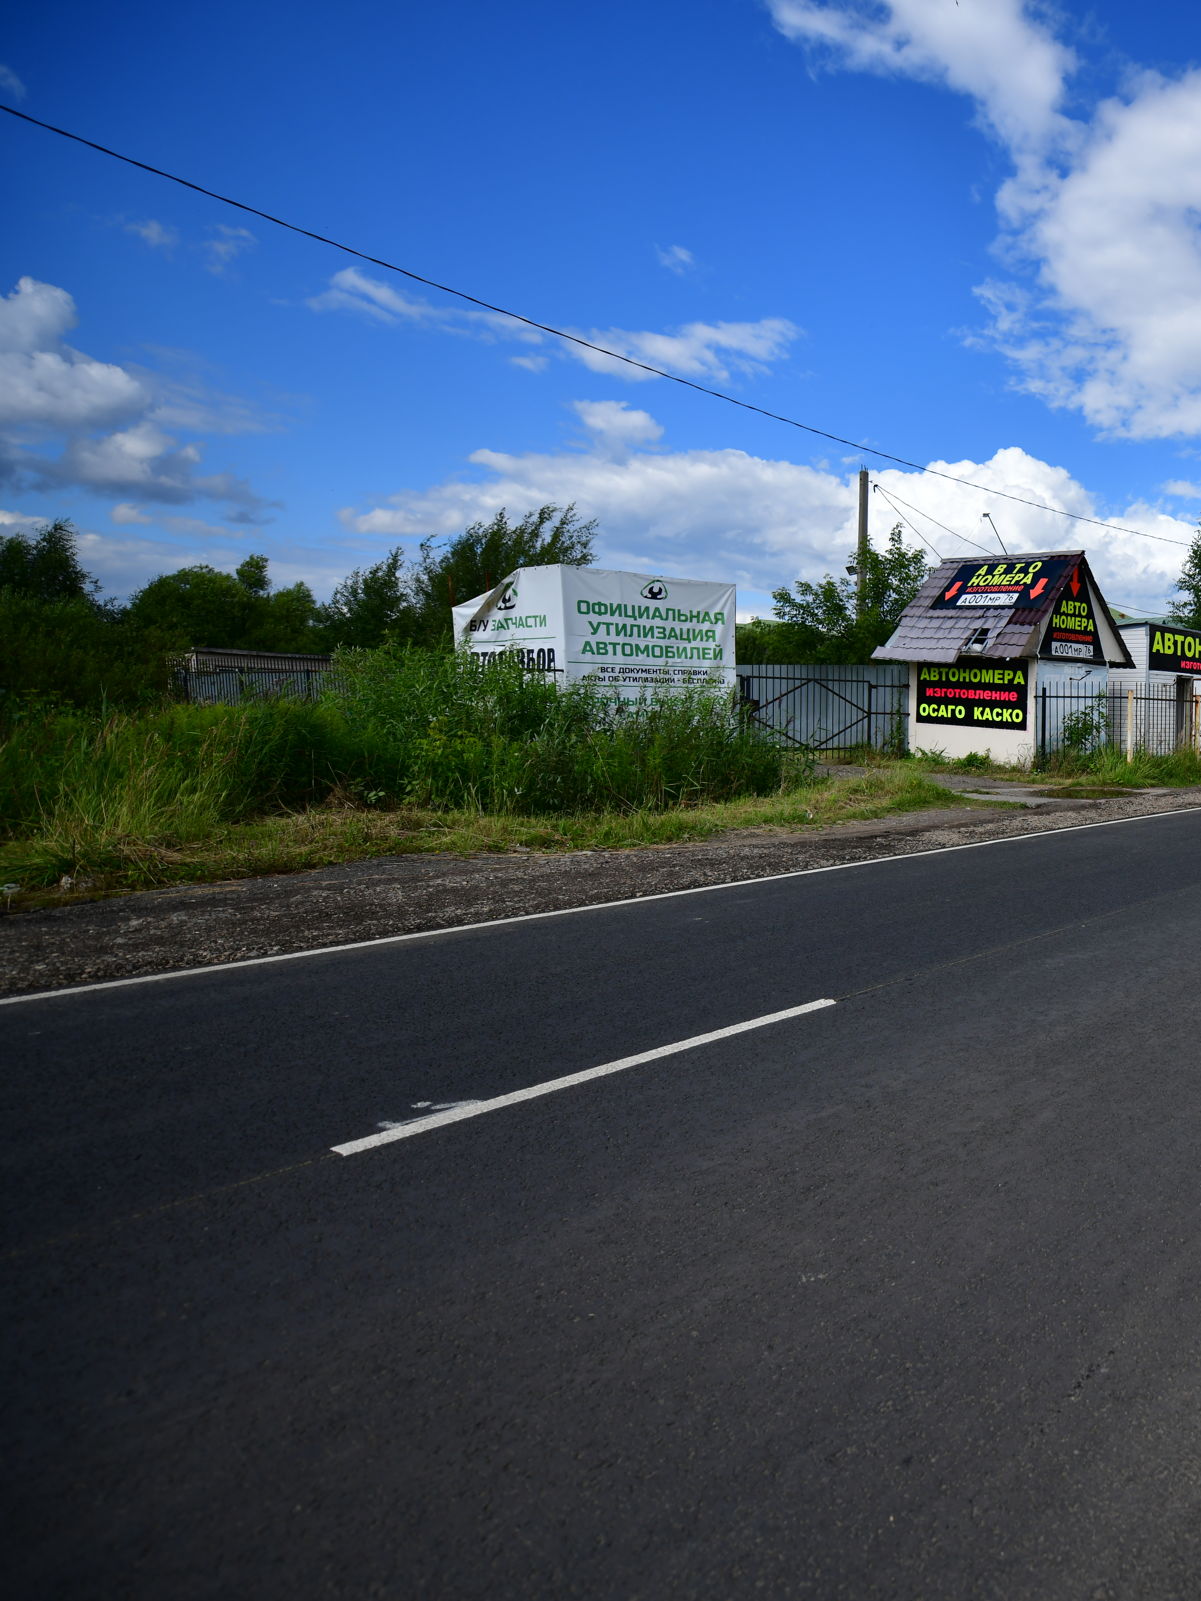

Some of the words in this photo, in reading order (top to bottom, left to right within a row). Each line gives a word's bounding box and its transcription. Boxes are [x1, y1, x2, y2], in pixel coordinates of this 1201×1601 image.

[974, 561, 1043, 576] АВТО
[967, 573, 1034, 586] НОМЕРА
[576, 600, 726, 625] ОФИЦИАЛЬНАЯ
[1060, 600, 1088, 616] АВТО
[469, 619, 489, 632] Б/У
[588, 620, 717, 643] УТИЛИЗАЦИЯ
[1052, 614, 1095, 632] НОМЕРА
[580, 641, 723, 661] АВТОМОБИЛЕЙ
[600, 666, 616, 674] ВСЕ
[920, 667, 1025, 685] АВТОНОМЕРА
[926, 688, 1018, 702] изготовление
[919, 703, 965, 719] ОСАГО
[973, 706, 1023, 723] КАСКО
